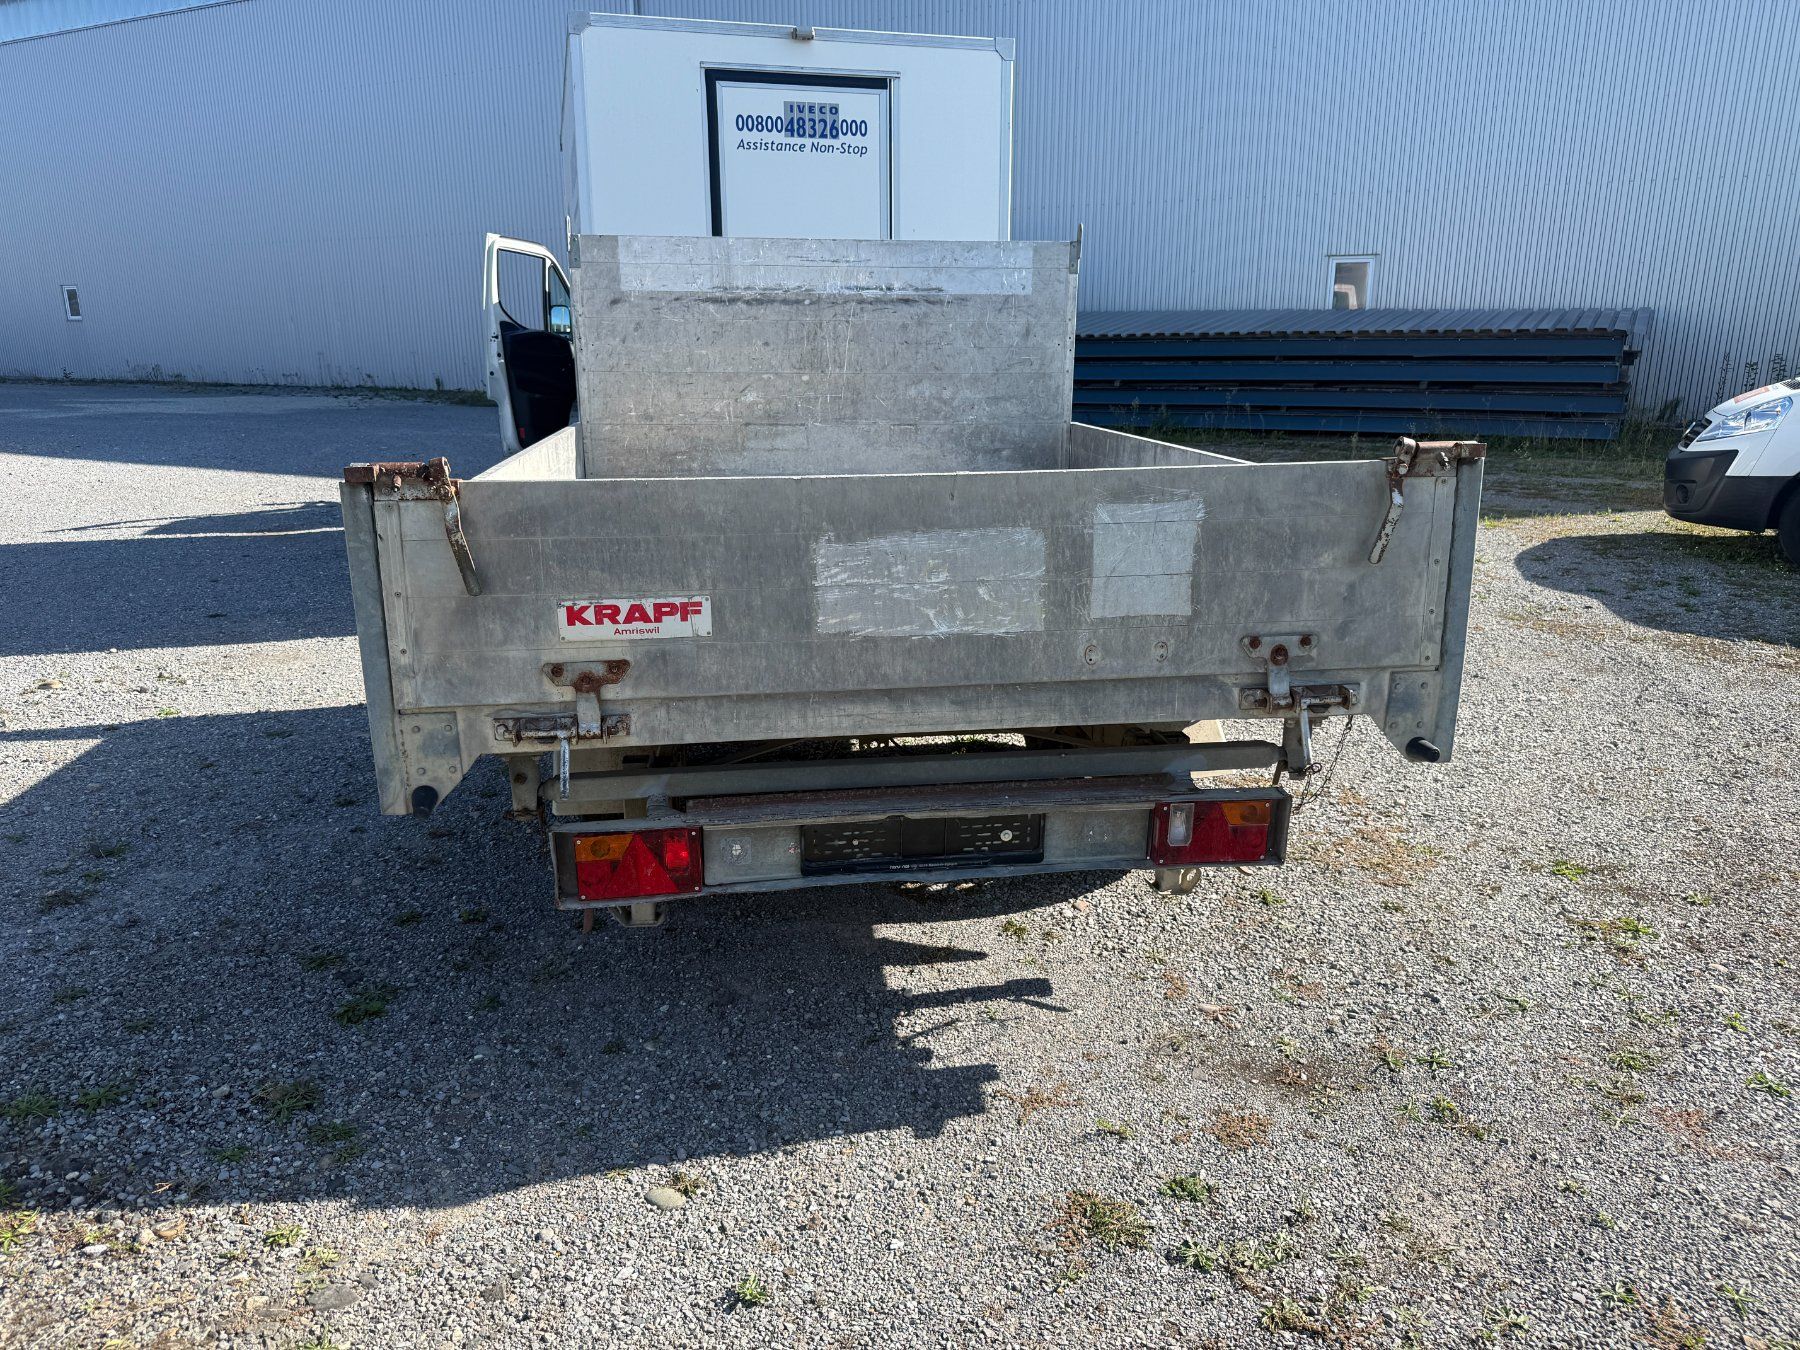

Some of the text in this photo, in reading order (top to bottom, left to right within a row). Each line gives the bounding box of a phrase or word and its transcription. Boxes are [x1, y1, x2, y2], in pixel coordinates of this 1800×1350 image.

[789, 104, 839, 115] IVECO
[737, 138, 868, 157] Assistance Non-Stop
[565, 601, 703, 626] KRAPF
[613, 626, 660, 636] Amriswil
